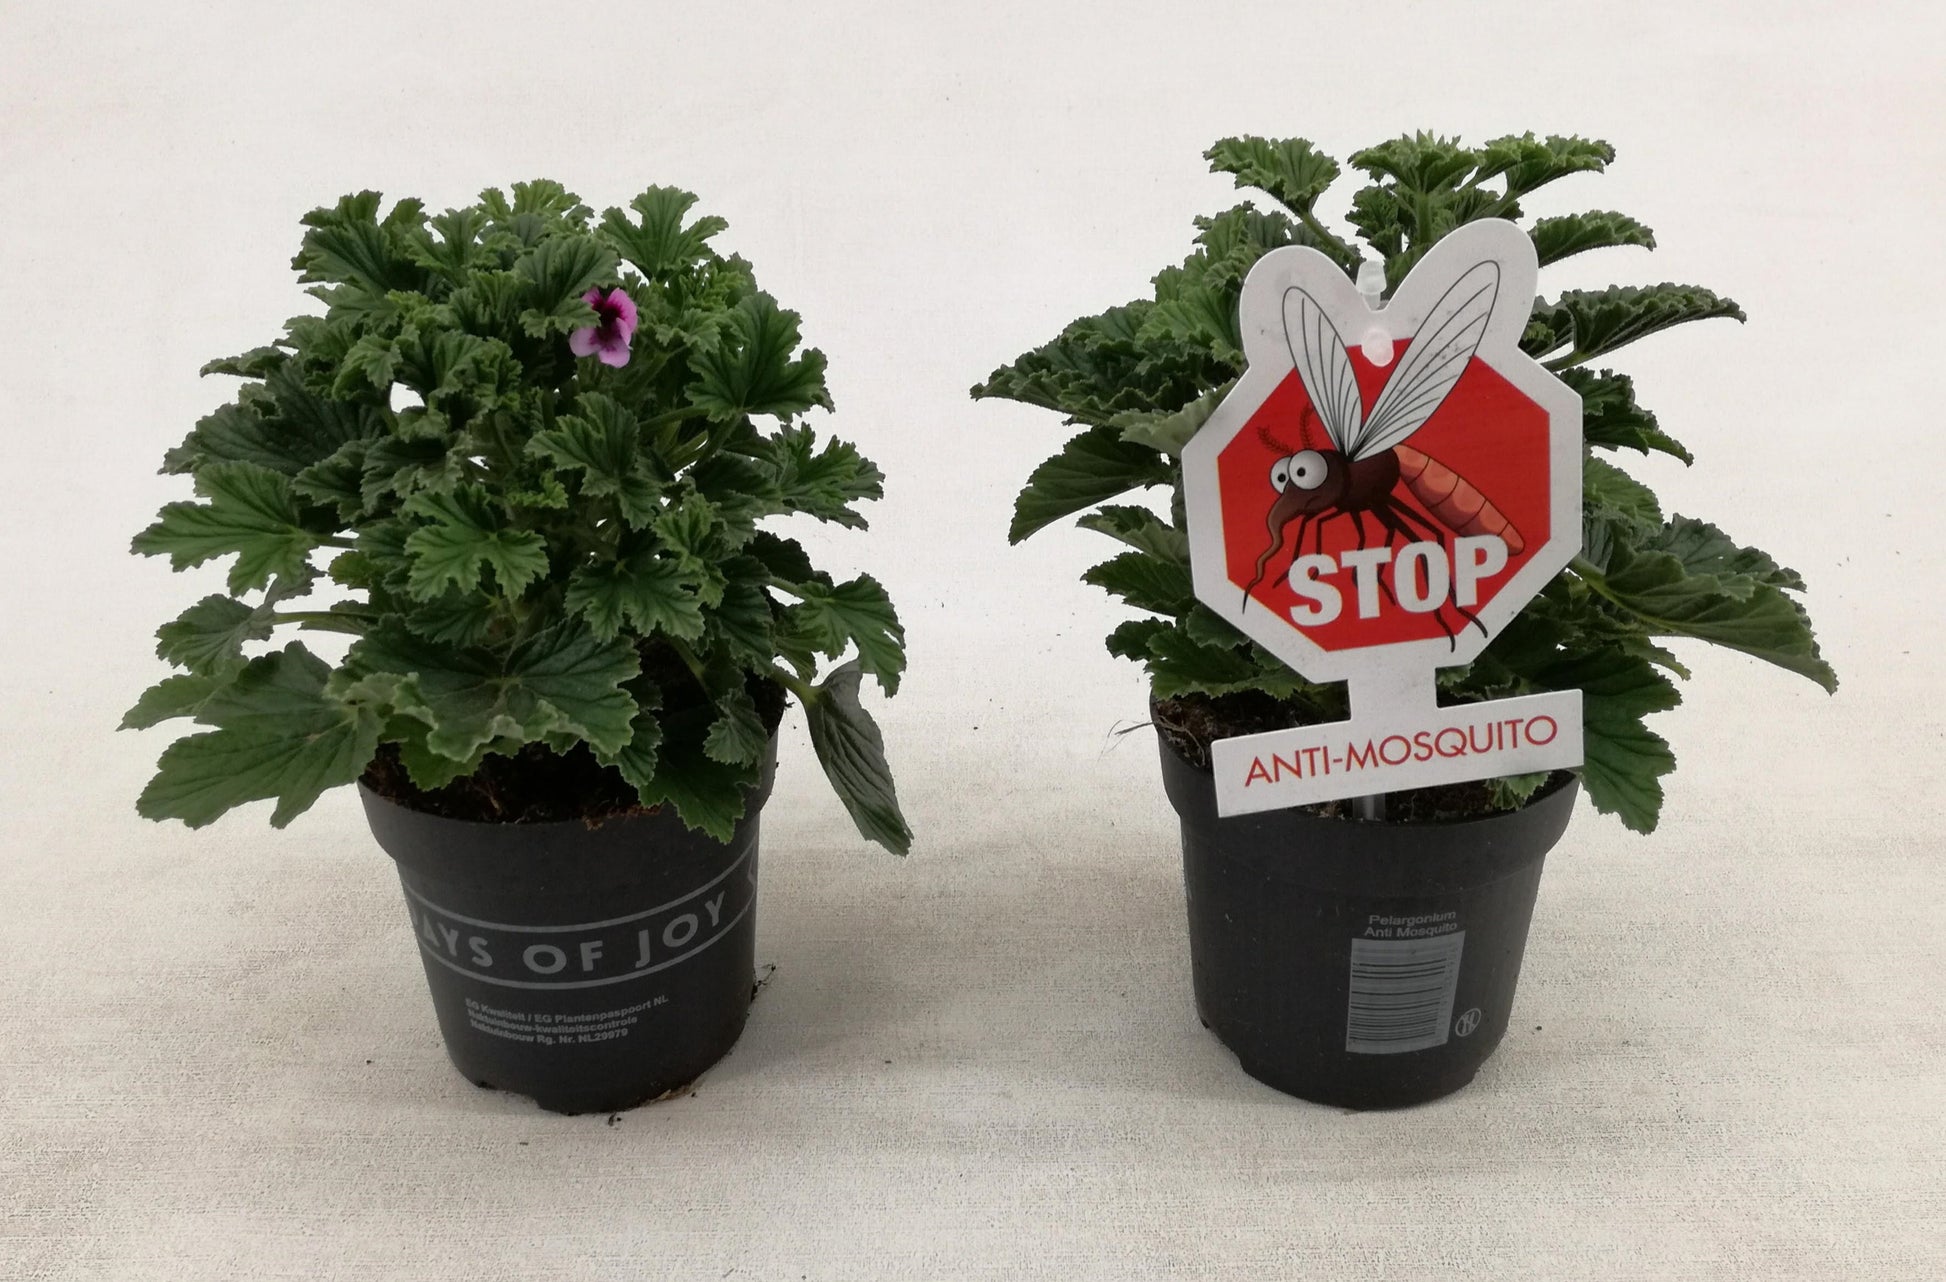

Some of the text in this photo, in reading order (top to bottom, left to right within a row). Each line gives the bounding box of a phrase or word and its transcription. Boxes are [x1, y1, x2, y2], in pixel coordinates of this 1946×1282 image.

[1288, 534, 1508, 627] STOP
[1245, 715, 1558, 787] ANTI-MOSQUITO
[412, 891, 725, 974] AYS OF JOY
[1364, 923, 1457, 937] Anti Mosquito
[1369, 911, 1456, 926] Pelargonium
[534, 1013, 552, 1023] EG
[555, 1001, 651, 1023] Plantenpaspoort
[653, 995, 669, 1006] NL
